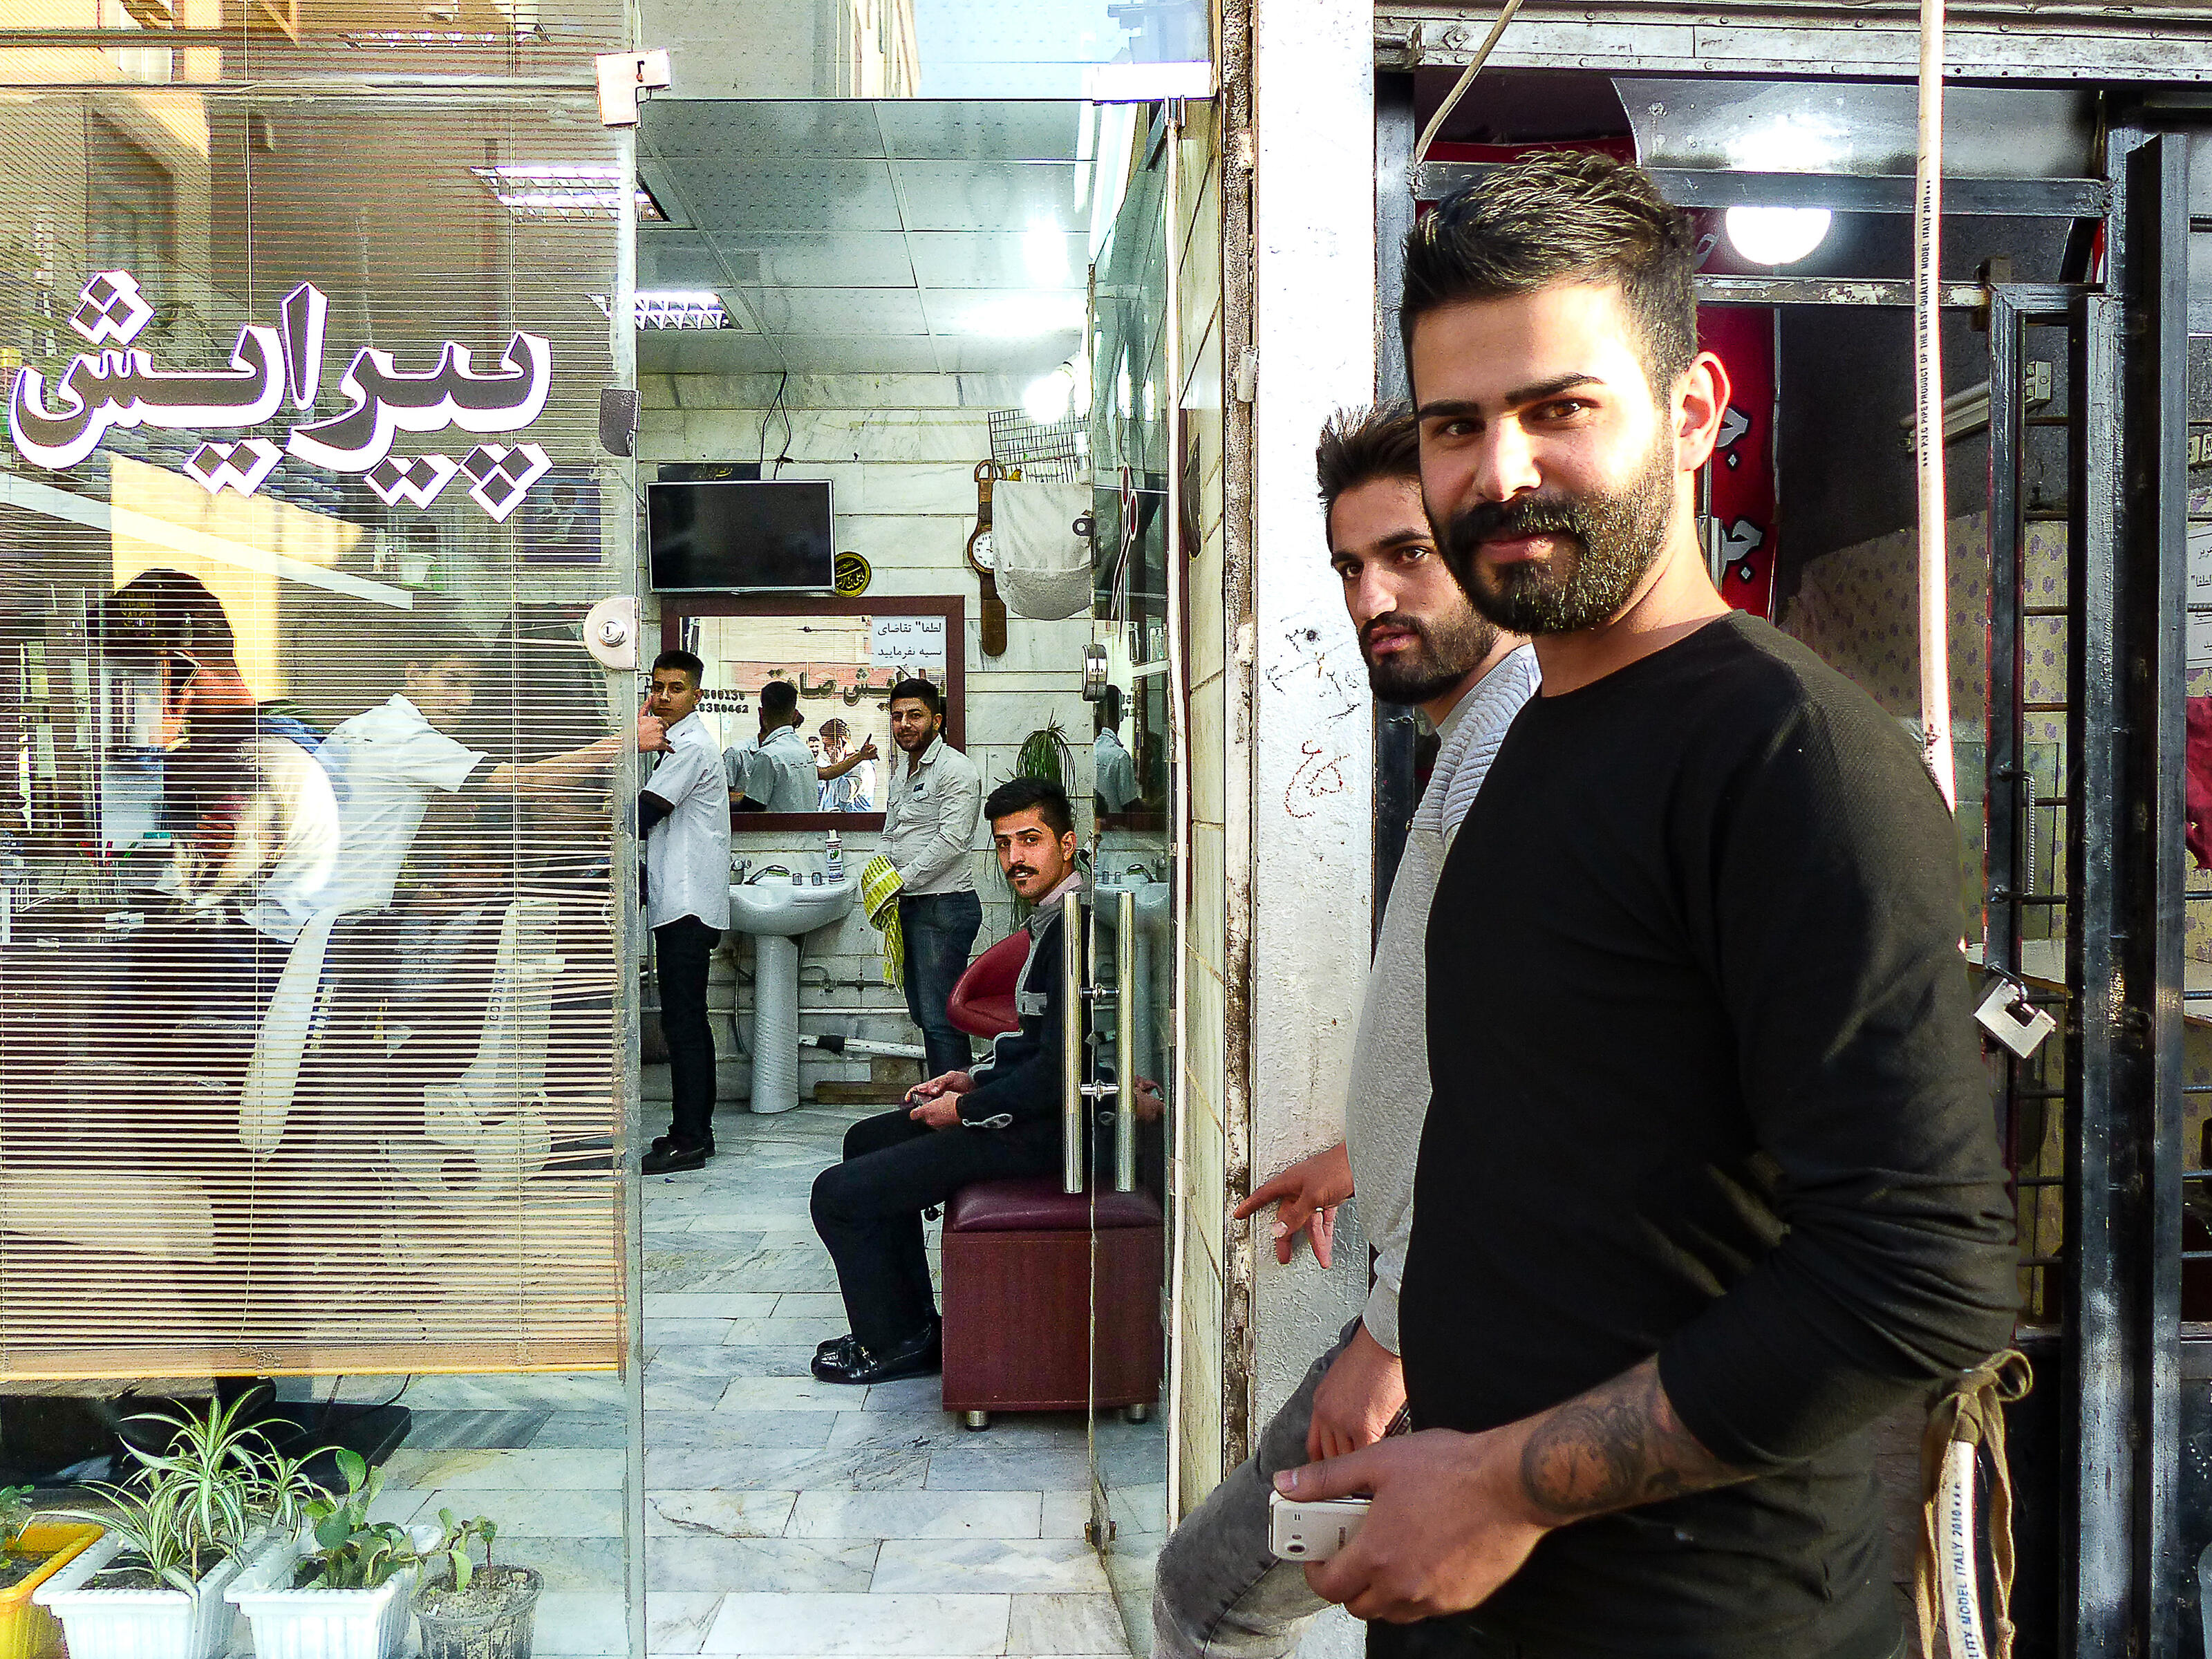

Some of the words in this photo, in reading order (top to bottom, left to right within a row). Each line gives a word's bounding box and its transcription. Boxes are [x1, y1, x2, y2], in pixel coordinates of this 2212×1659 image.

[1922, 217, 1931, 238] ITALY
[1921, 242, 1929, 270] MODEL
[1920, 274, 1928, 306] QUALITY
[1920, 353, 1928, 364] OF
[9, 268, 554, 523] پیرایش
[877, 622, 912, 636] تقاضای
[1952, 1541, 1966, 1576] ITALY
[1957, 1583, 1971, 1624] MODEL
